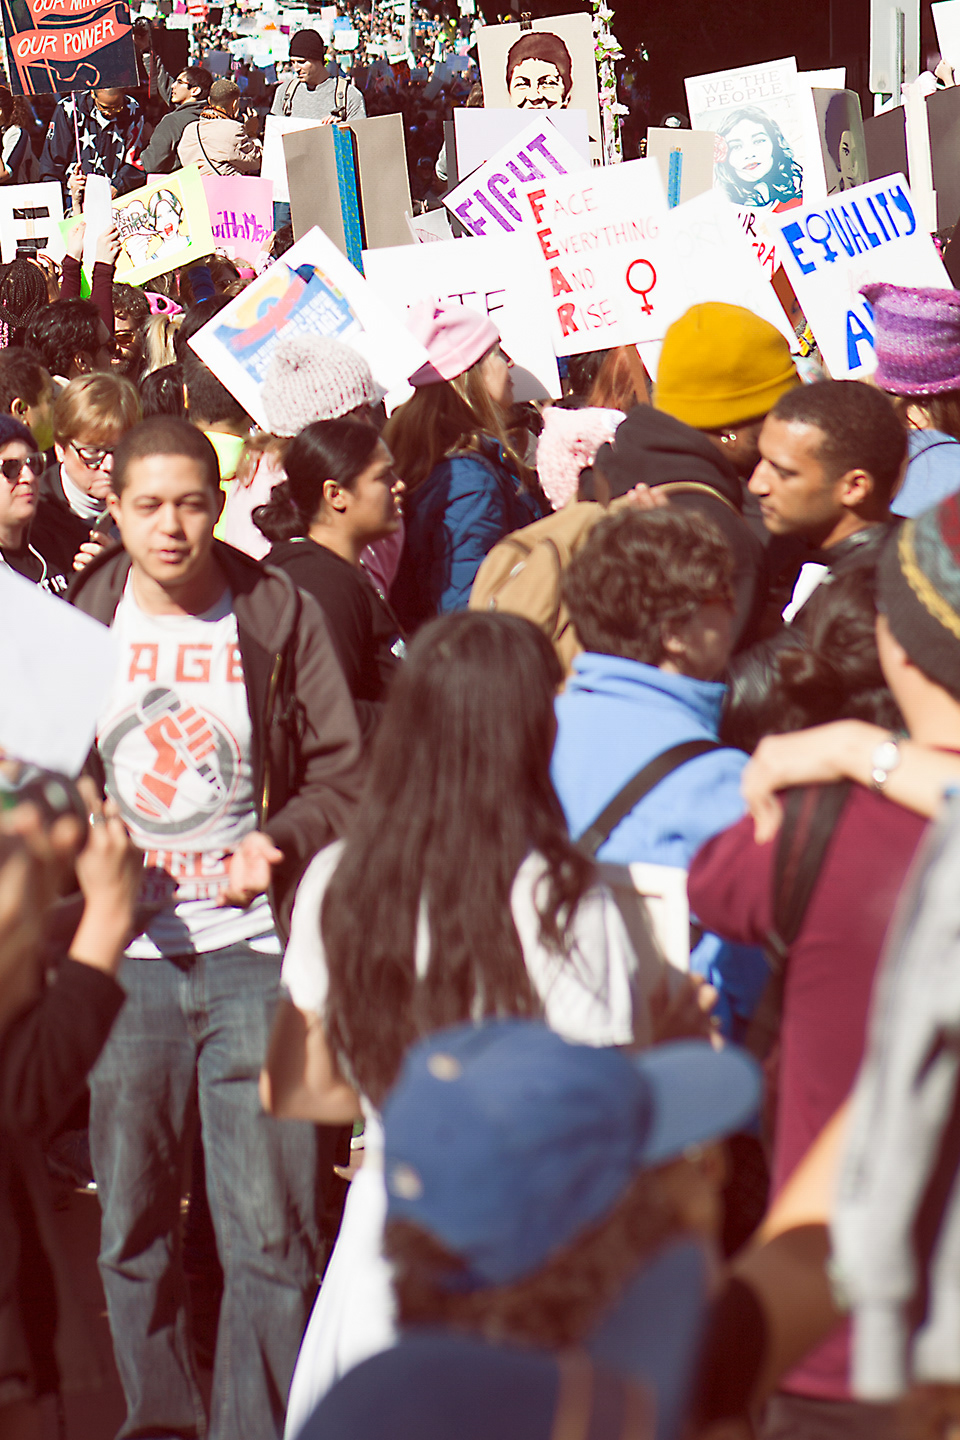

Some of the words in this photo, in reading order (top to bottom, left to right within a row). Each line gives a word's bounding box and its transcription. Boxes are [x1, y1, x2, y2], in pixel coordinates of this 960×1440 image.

[17, 35, 58, 58] OUR
[63, 19, 115, 55] POWER
[702, 79, 734, 95] WE
[740, 70, 781, 87] THE
[705, 82, 783, 108] PEOPLE
[526, 188, 601, 225] FACE
[536, 215, 659, 261] EVERYTHING
[550, 266, 596, 298] AND
[556, 298, 618, 338] RISE
